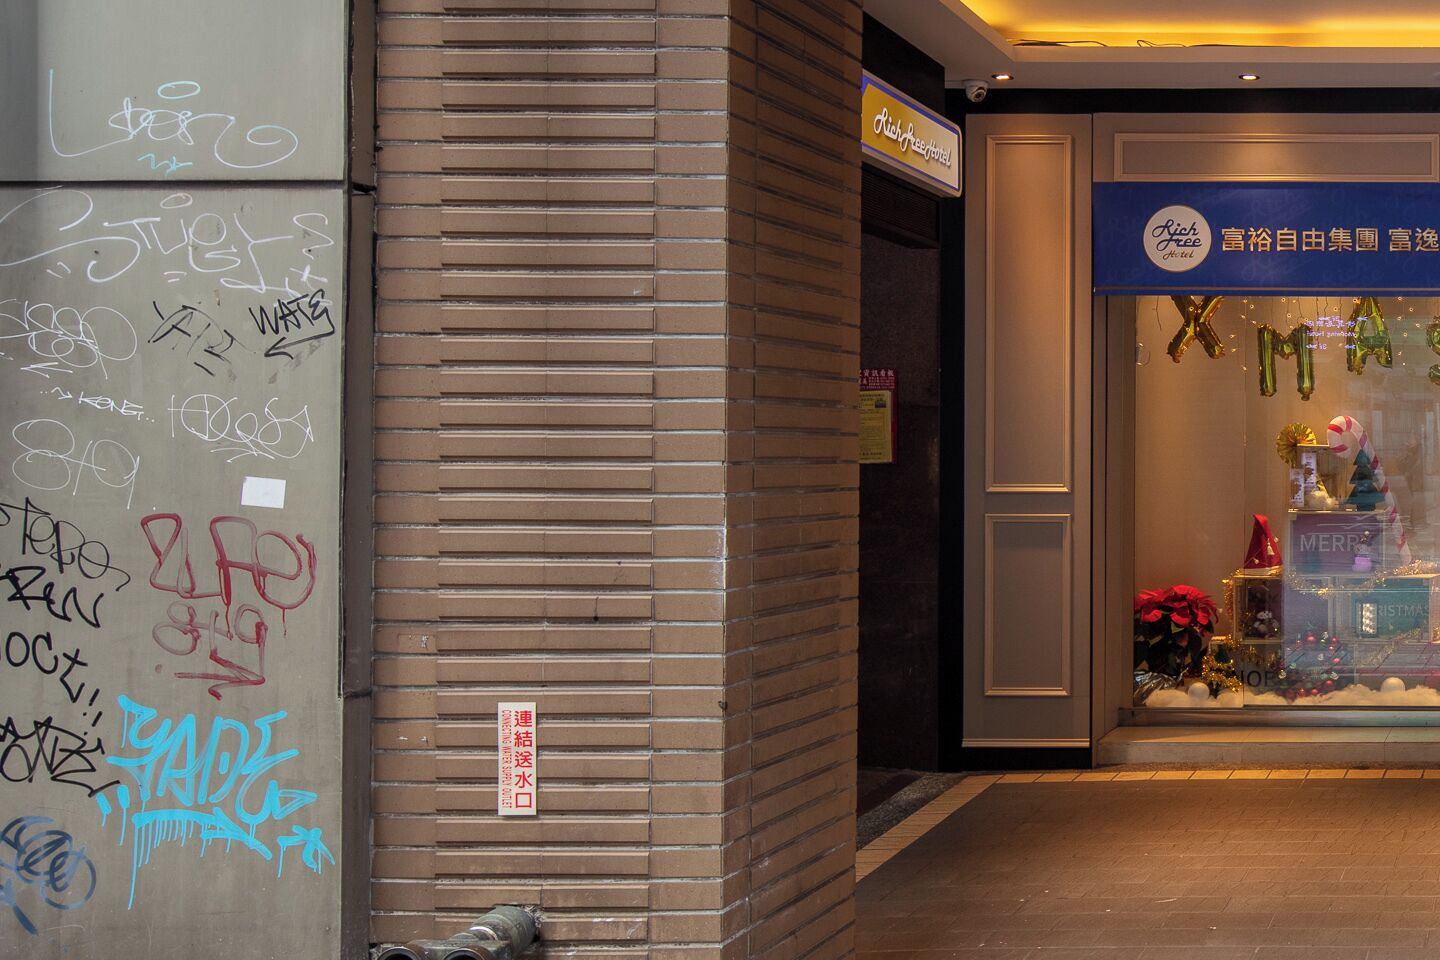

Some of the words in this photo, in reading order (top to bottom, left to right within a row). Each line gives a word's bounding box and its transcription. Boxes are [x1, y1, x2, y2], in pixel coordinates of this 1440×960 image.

[1151, 218, 1199, 238] Rich
[1156, 236, 1203, 252] Free
[1221, 227, 1380, 253] 富裕自由集團
[1162, 250, 1195, 260] Hotel
[513, 710, 533, 809] 連結送水口
